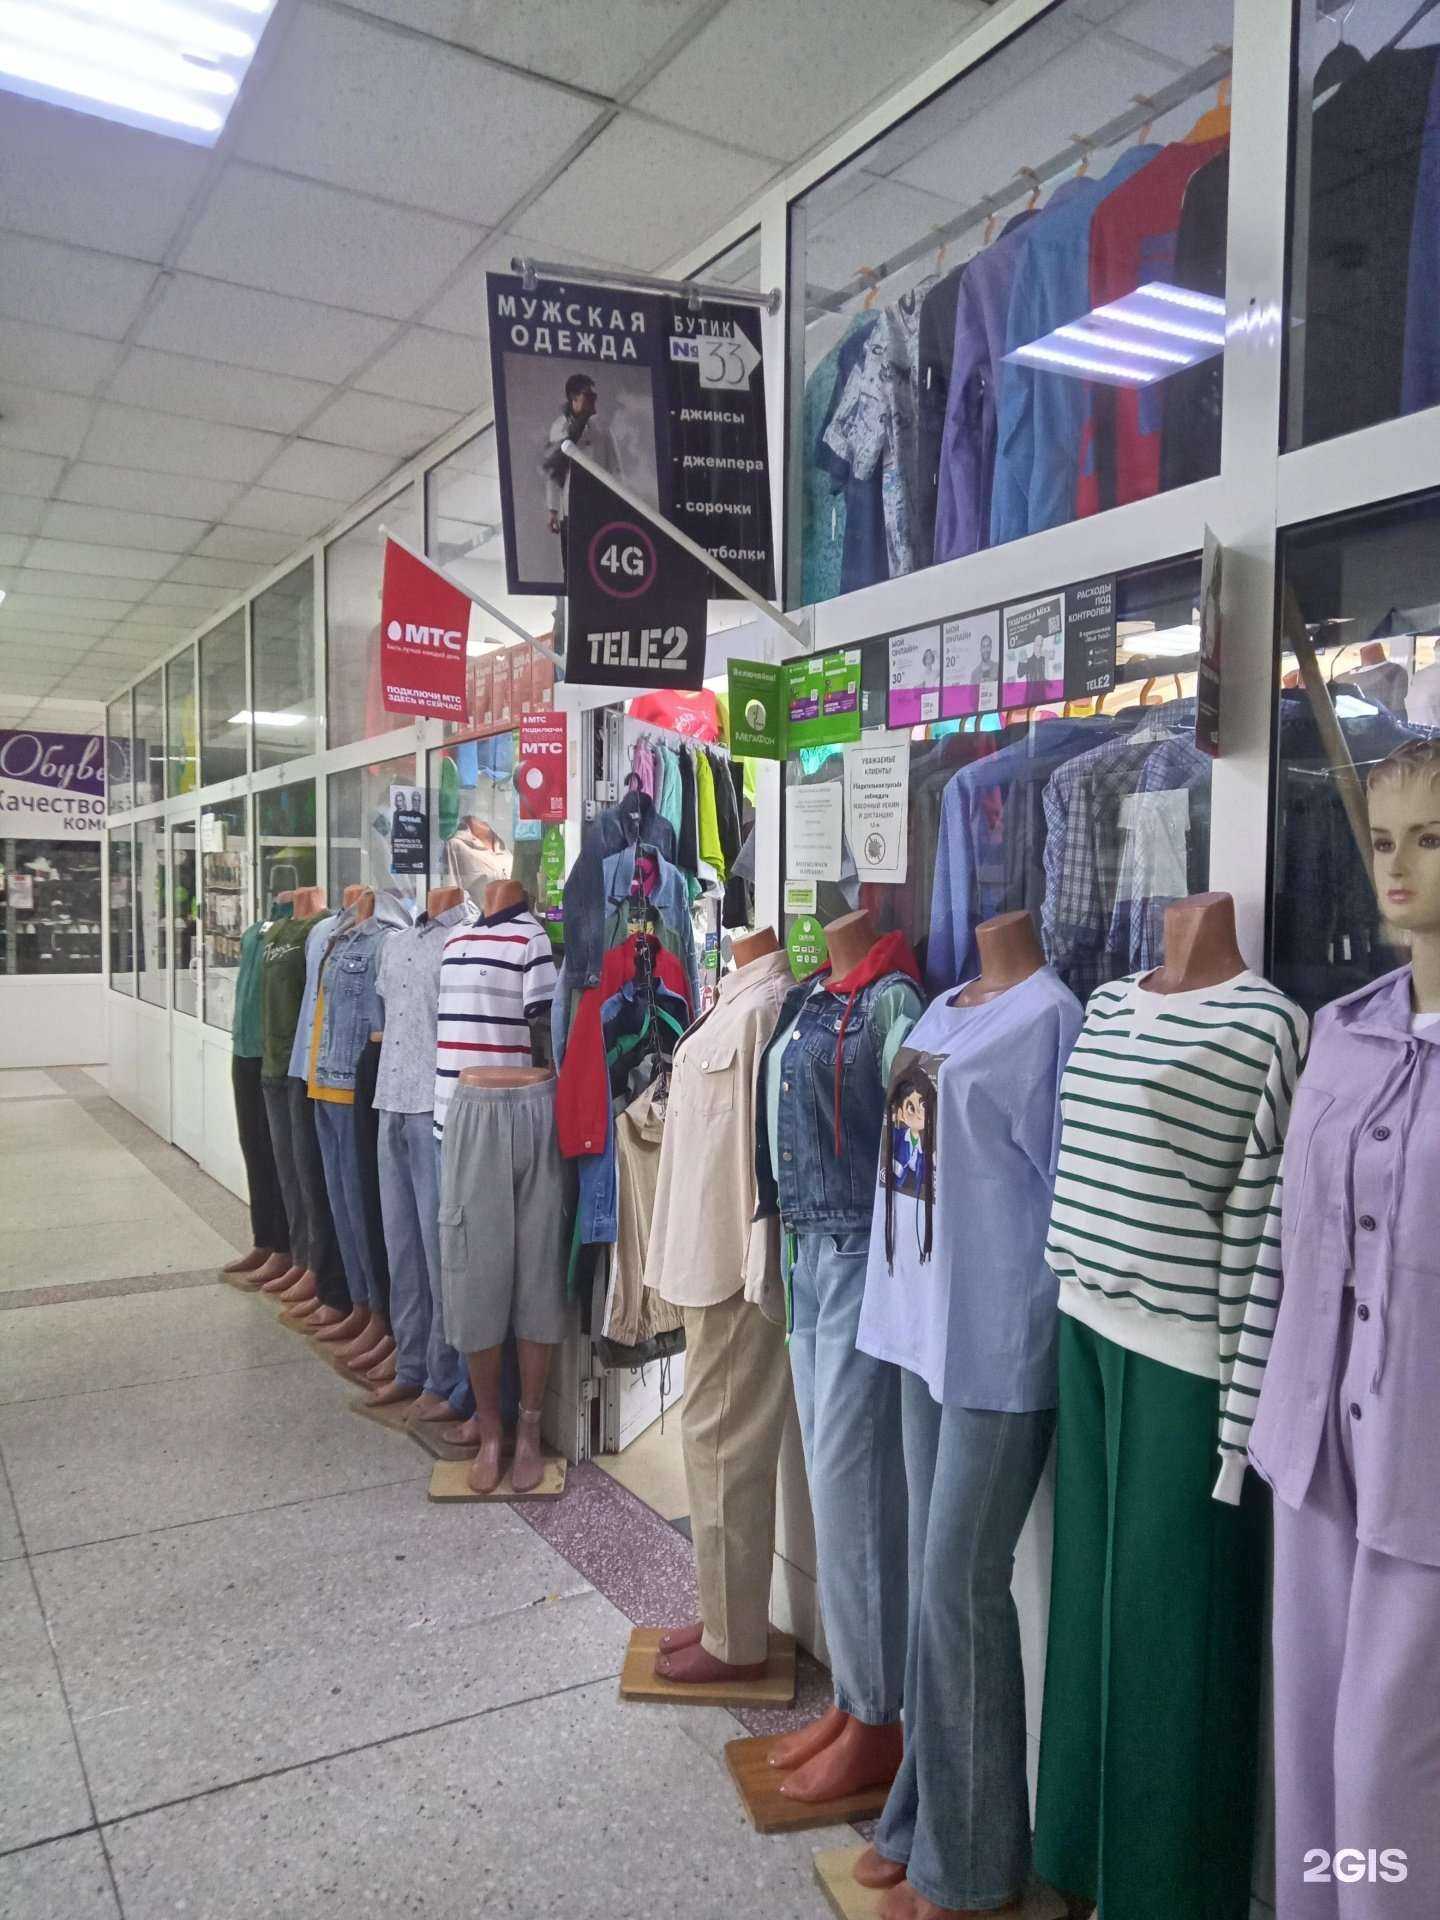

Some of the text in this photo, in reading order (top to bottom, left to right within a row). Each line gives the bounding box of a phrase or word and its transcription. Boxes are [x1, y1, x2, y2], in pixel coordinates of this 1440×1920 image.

[497, 294, 646, 333] МУЖСКАЯ
[673, 315, 732, 338] БУТИК
[510, 324, 638, 361] ОДЕЖДА
[705, 341, 746, 385] 33
[680, 408, 745, 424] джинсы
[682, 455, 764, 472] джемпера
[686, 501, 752, 516] сорочки
[600, 544, 644, 576] 4G
[1077, 583, 1112, 600] РАСХОДЫ
[1095, 594, 1112, 606] ПОД
[1068, 605, 1112, 623] КОНТРОЛЕМ
[405, 623, 462, 650] МТС
[587, 626, 688, 670] TELE2
[1086, 674, 1111, 691] TELE2
[387, 685, 461, 704] ПОДКЛЮЧИ МТС
[388, 694, 417, 704] ЗДЕСЬ
[528, 716, 547, 724] МТС
[522, 742, 563, 754] МТС
